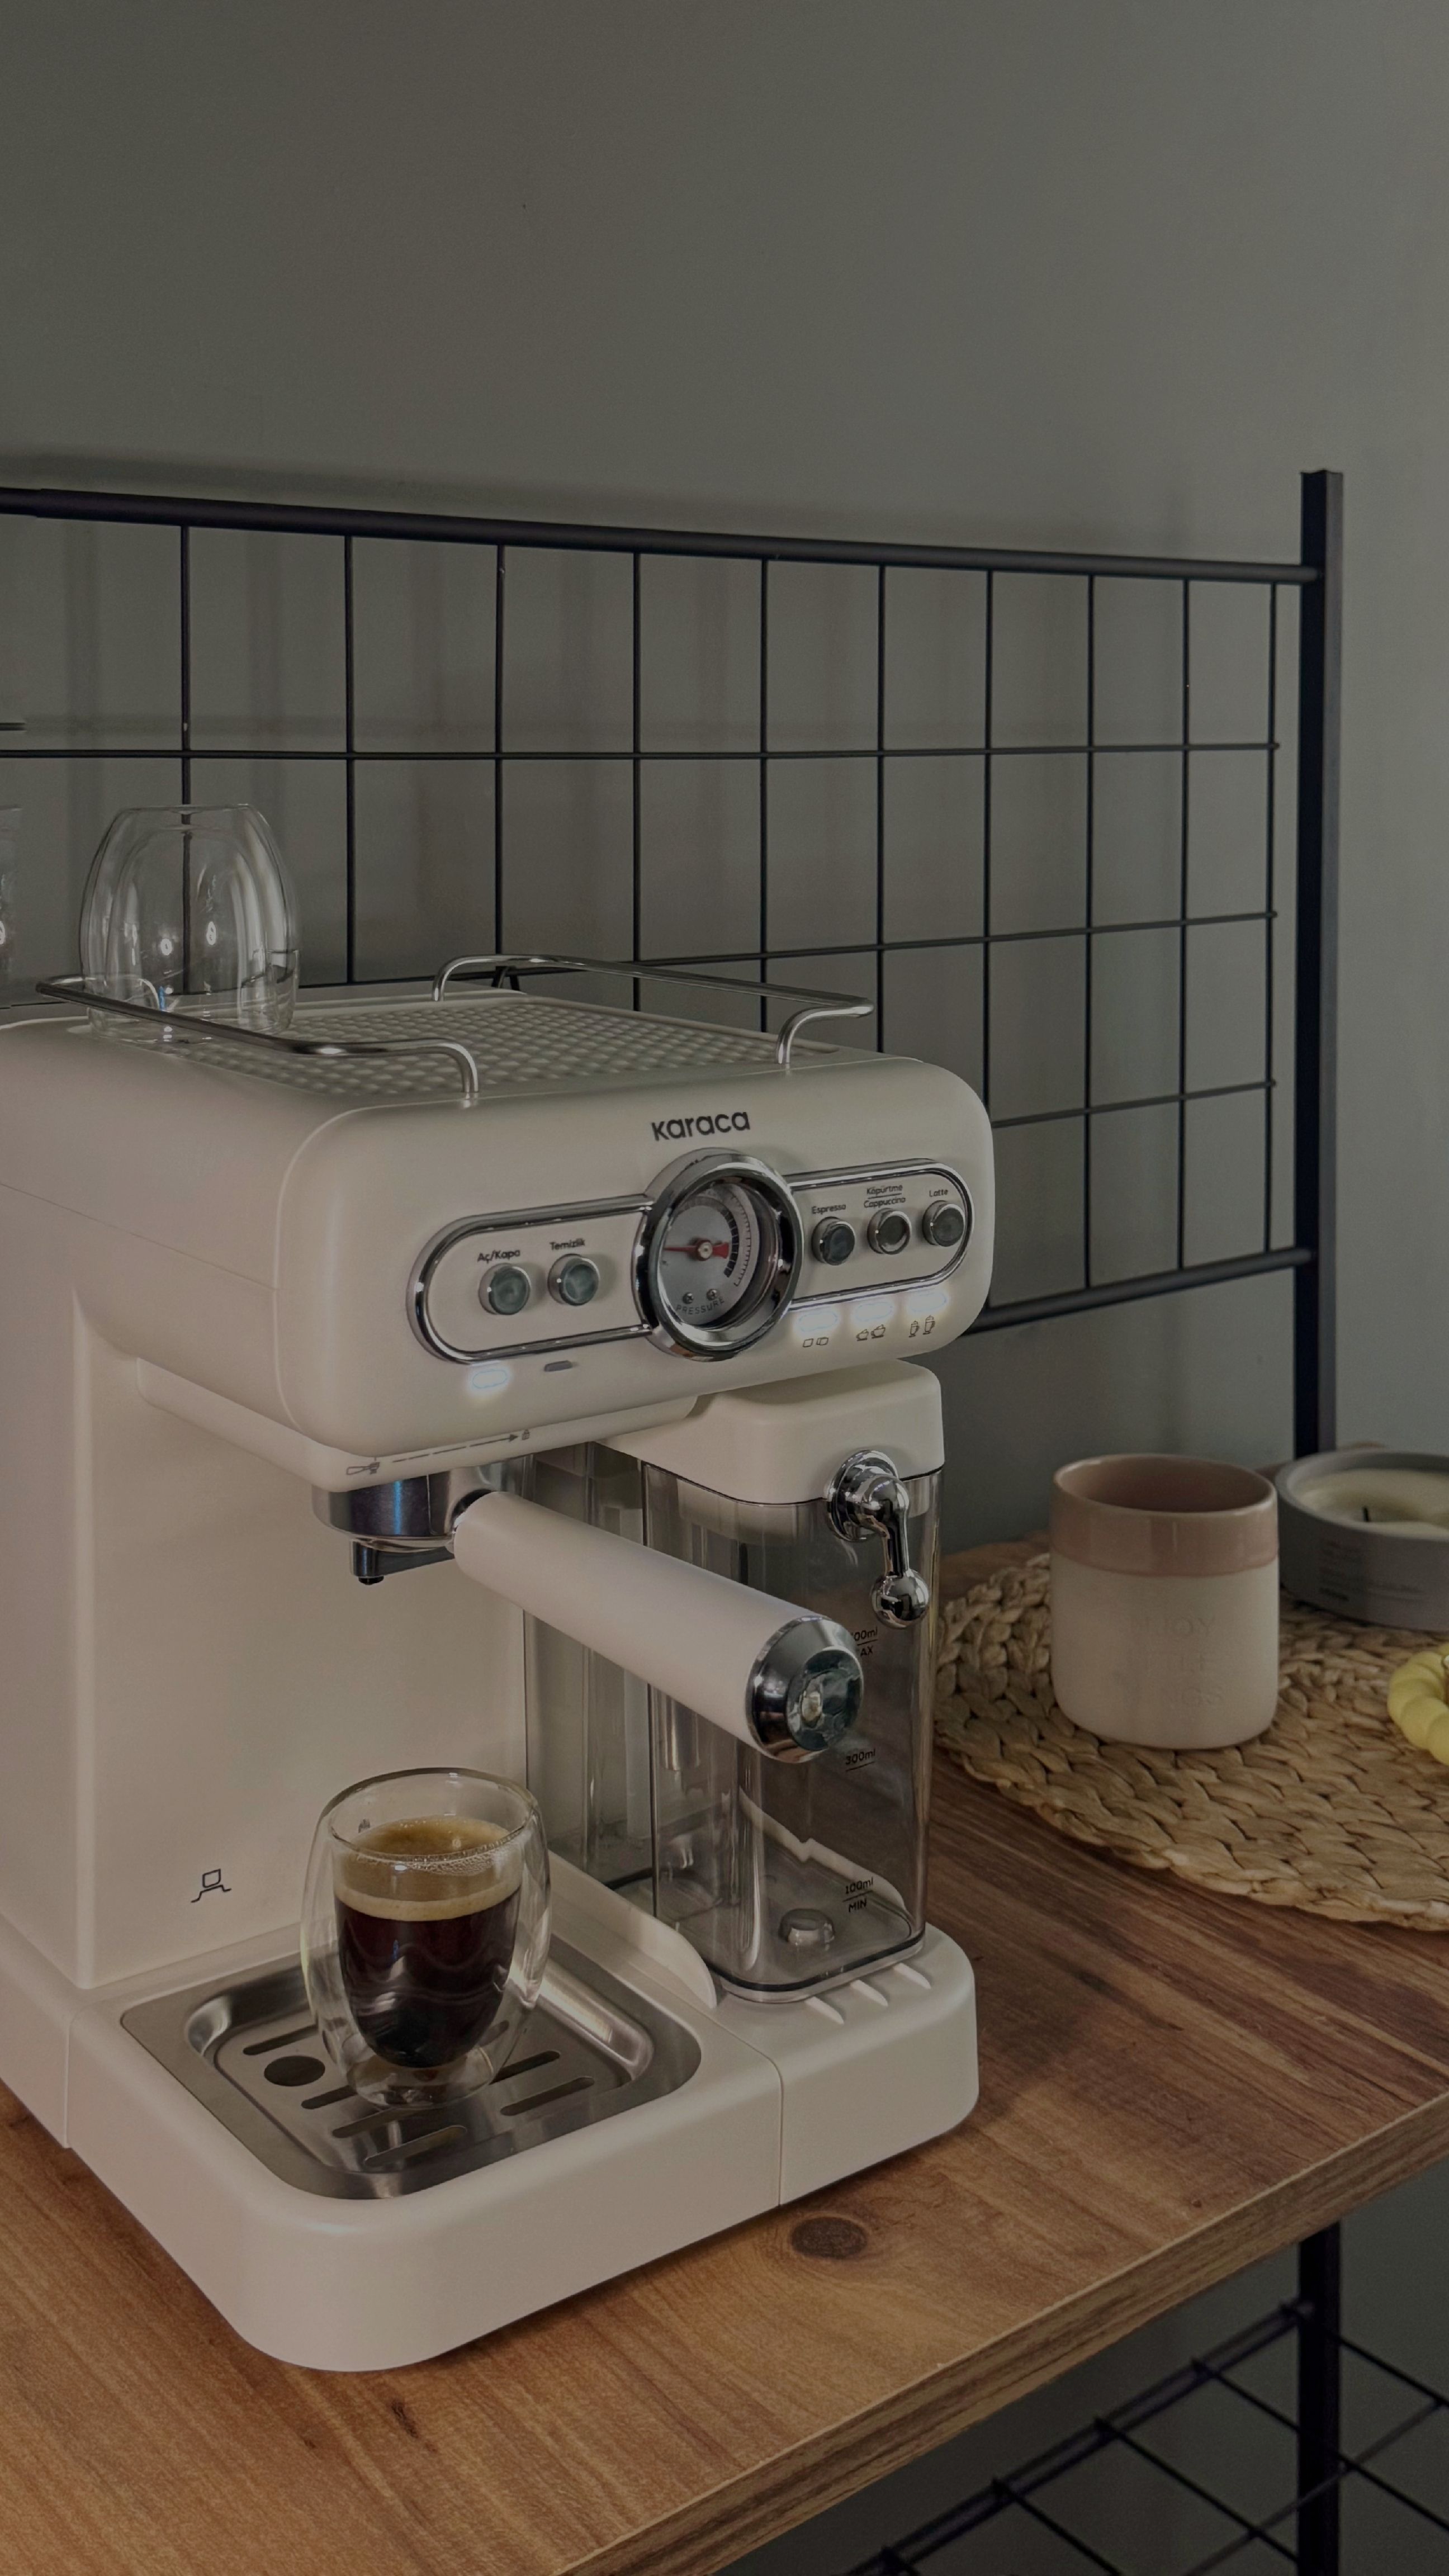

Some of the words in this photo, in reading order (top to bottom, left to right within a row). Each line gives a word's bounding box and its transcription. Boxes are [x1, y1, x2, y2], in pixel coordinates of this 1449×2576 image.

[651, 1111, 750, 1142] karaca
[929, 1188, 948, 1197] Latte
[811, 1204, 846, 1215] Espresso
[864, 1197, 906, 1209] Cappuccino
[549, 1237, 585, 1251] Temizlik
[675, 1297, 725, 1315] PRESSURE
[851, 1626, 878, 1642] 00ml
[857, 1645, 874, 1656] AX
[845, 1749, 876, 1765] 300ml
[846, 1877, 873, 1894] 100ml
[849, 1897, 866, 1912] MIN
